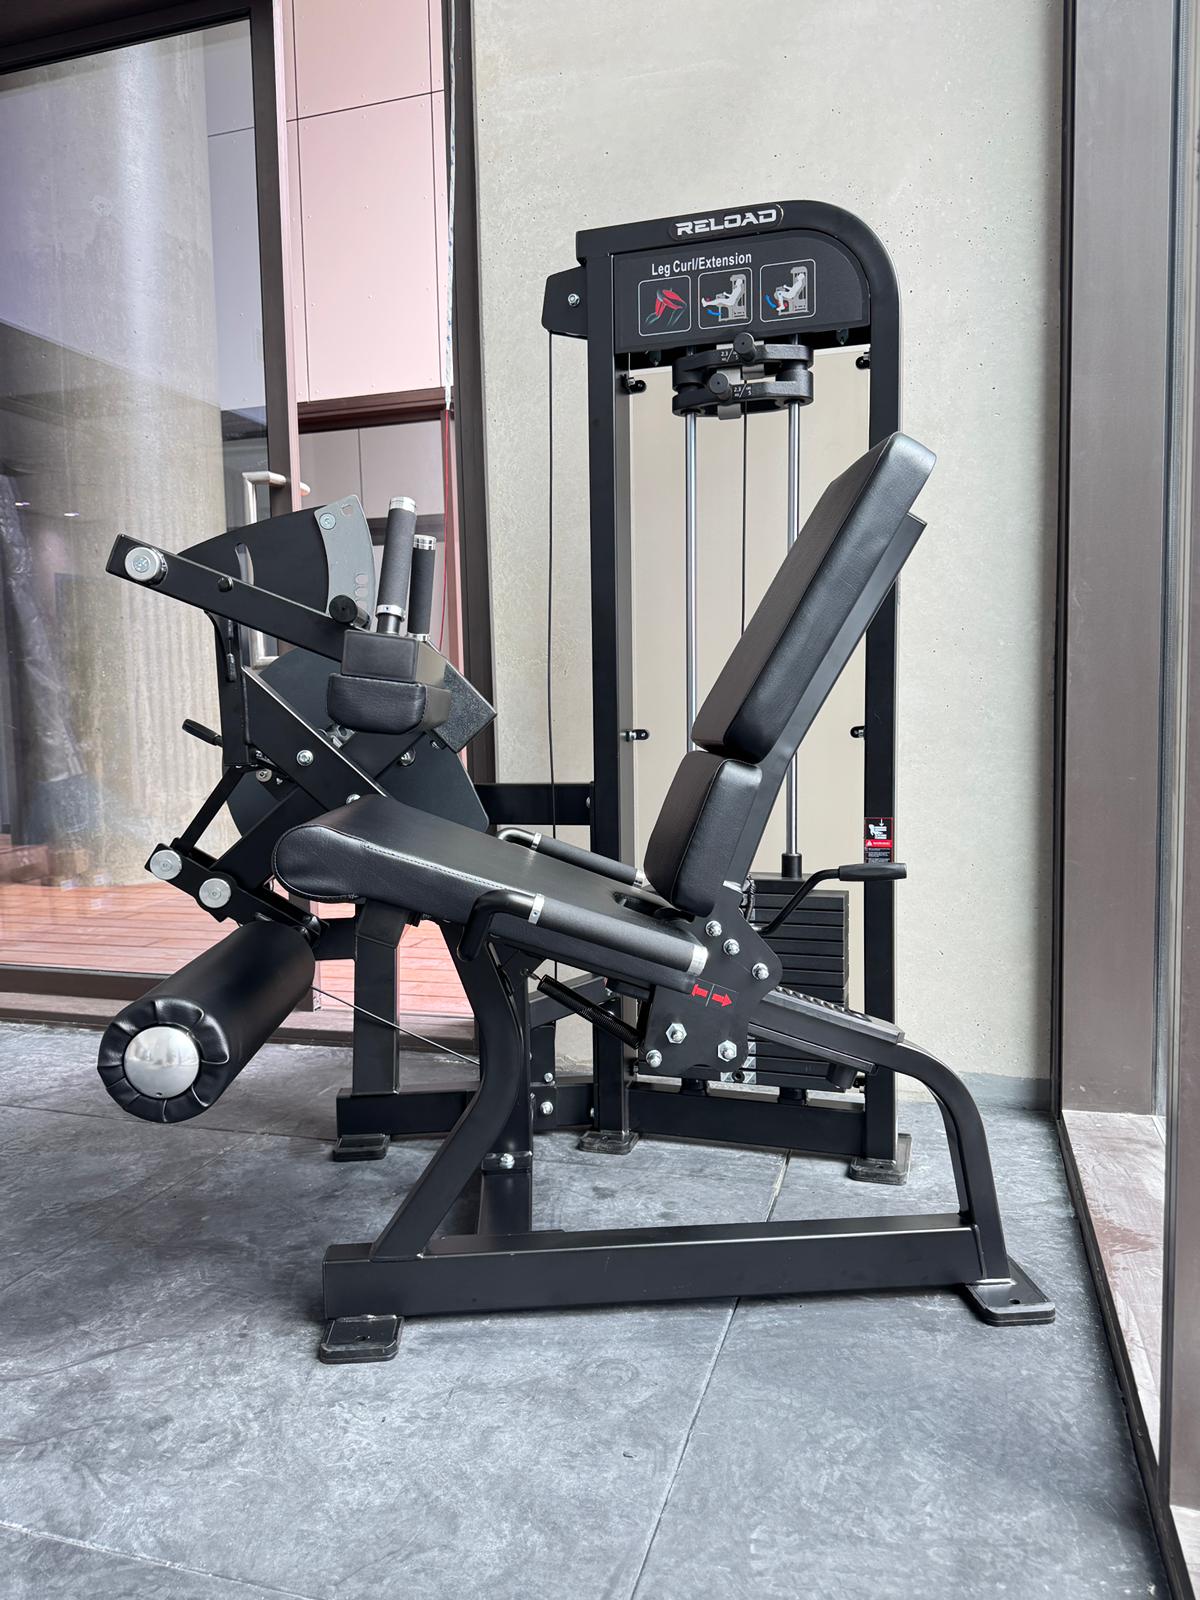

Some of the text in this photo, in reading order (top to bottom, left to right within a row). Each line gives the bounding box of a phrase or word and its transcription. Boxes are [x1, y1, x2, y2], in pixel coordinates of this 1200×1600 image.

[675, 209, 777, 236] RELOAD
[651, 252, 752, 277] Leg Curl/Extension
